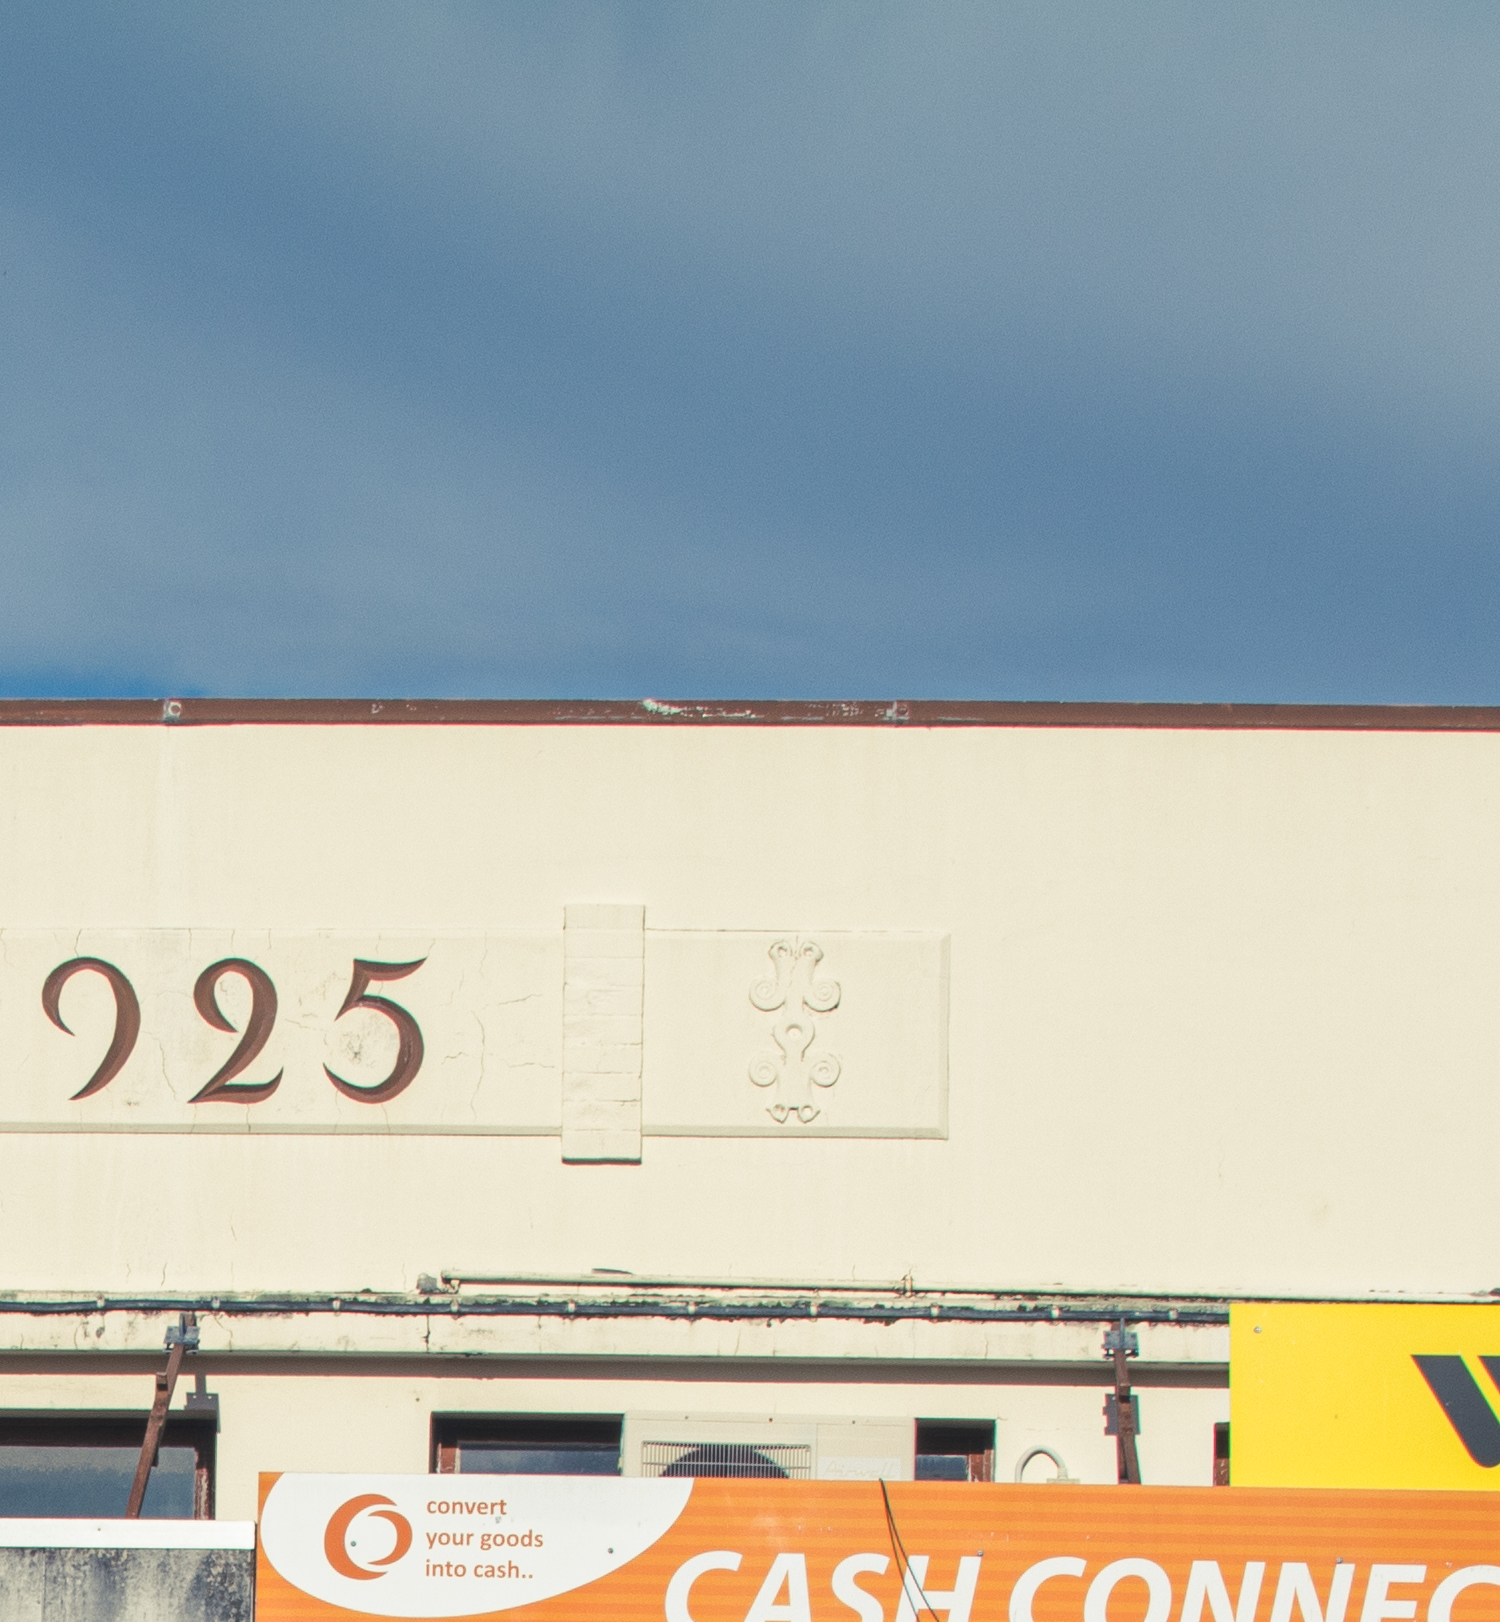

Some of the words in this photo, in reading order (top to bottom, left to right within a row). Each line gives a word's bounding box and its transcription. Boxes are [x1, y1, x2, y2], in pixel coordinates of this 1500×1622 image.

[426, 1496, 508, 1517] convert
[426, 1530, 473, 1552] your
[479, 1526, 545, 1552] goods
[425, 1558, 465, 1579] into
[469, 1558, 535, 1580] cash..
